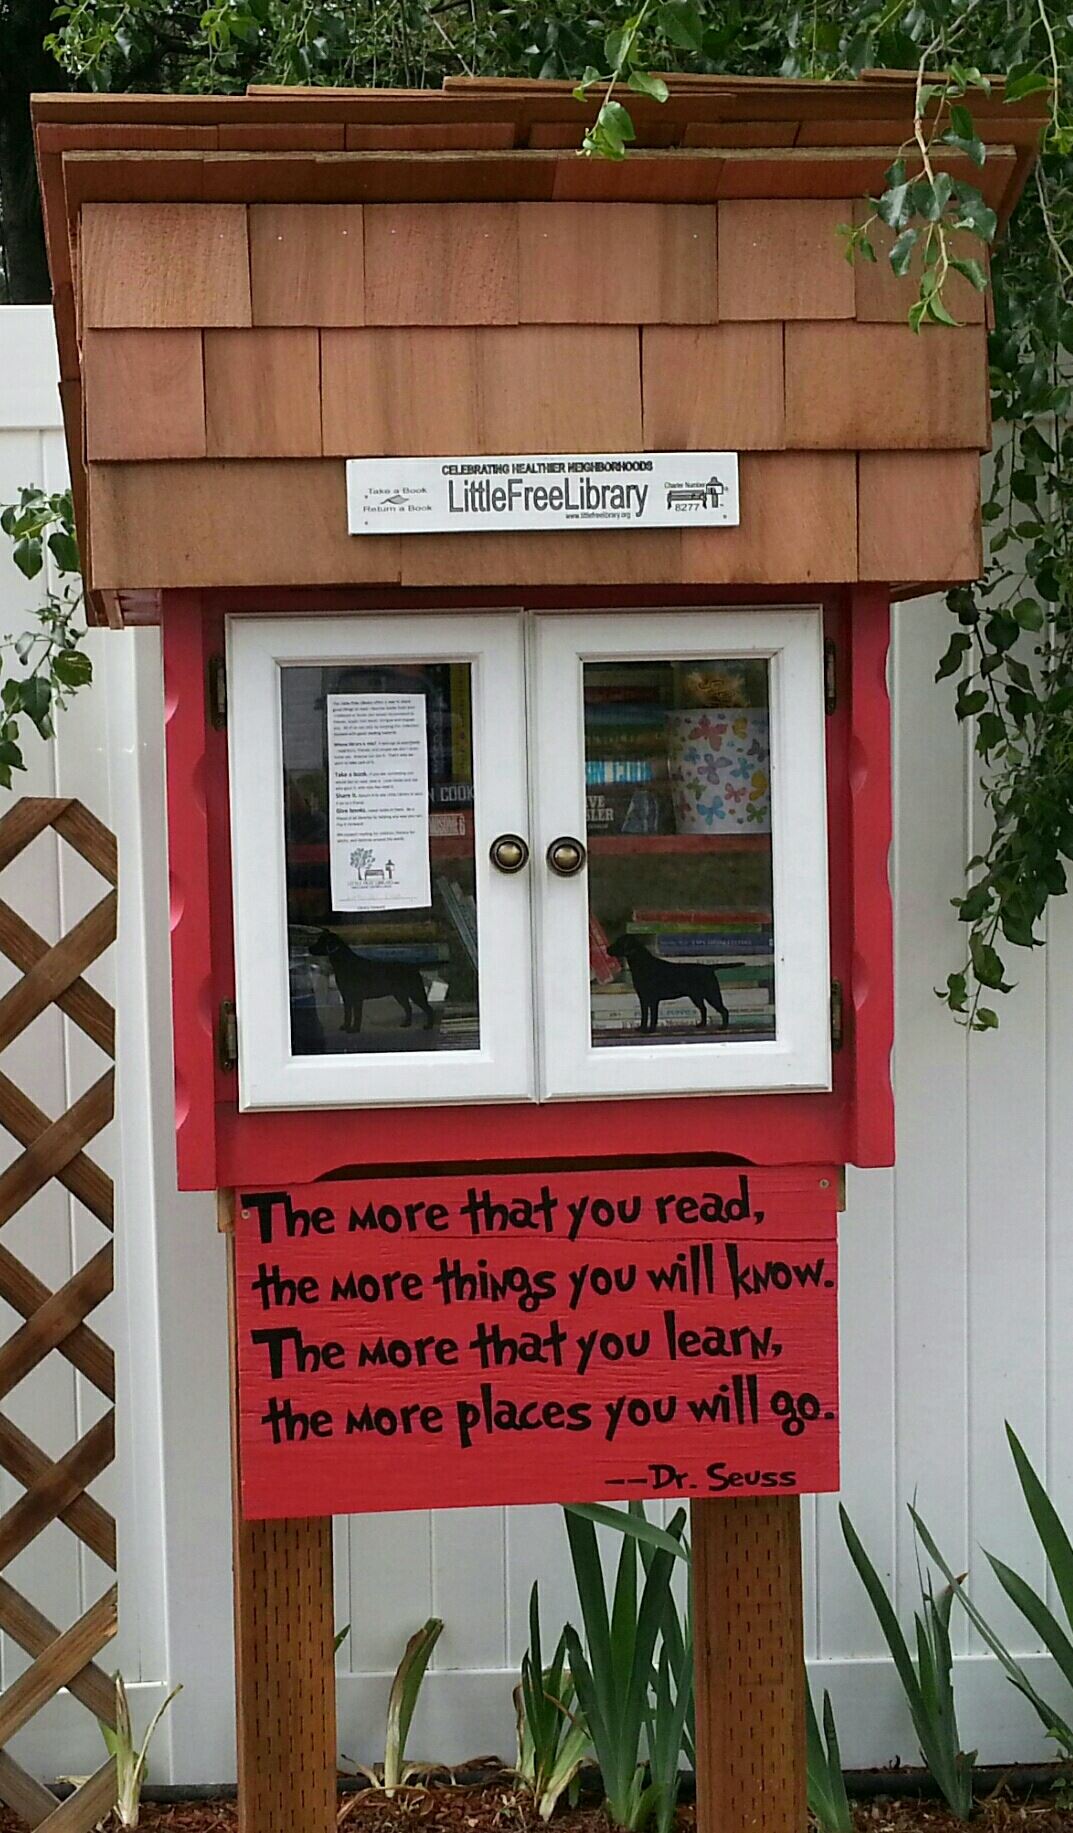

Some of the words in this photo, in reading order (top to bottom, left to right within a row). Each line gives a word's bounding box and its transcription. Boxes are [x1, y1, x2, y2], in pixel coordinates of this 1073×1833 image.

[442, 464, 510, 475] CELEBRATING
[512, 463, 566, 474] HEALTHIER
[568, 461, 653, 473] NEIGHBORHOODS
[449, 477, 648, 517] LittleFreeLibrary
[675, 503, 700, 511] 8277
[240, 1191, 335, 1244] The
[460, 1186, 558, 1234] that
[567, 1195, 641, 1242] you
[656, 1175, 764, 1224] read,
[252, 1263, 319, 1310] the
[433, 1256, 556, 1312] things
[569, 1264, 636, 1310] you
[647, 1242, 713, 1293] will
[725, 1242, 834, 1300] know.
[251, 1327, 345, 1379] The
[469, 1320, 567, 1369] that
[577, 1329, 650, 1375] you
[664, 1310, 782, 1360] learn,
[261, 1397, 332, 1444] the
[457, 1383, 592, 1448] places
[605, 1396, 676, 1441] you
[688, 1374, 758, 1424] will
[770, 1391, 834, 1436] go.
[707, 1462, 796, 1491] Seuss
